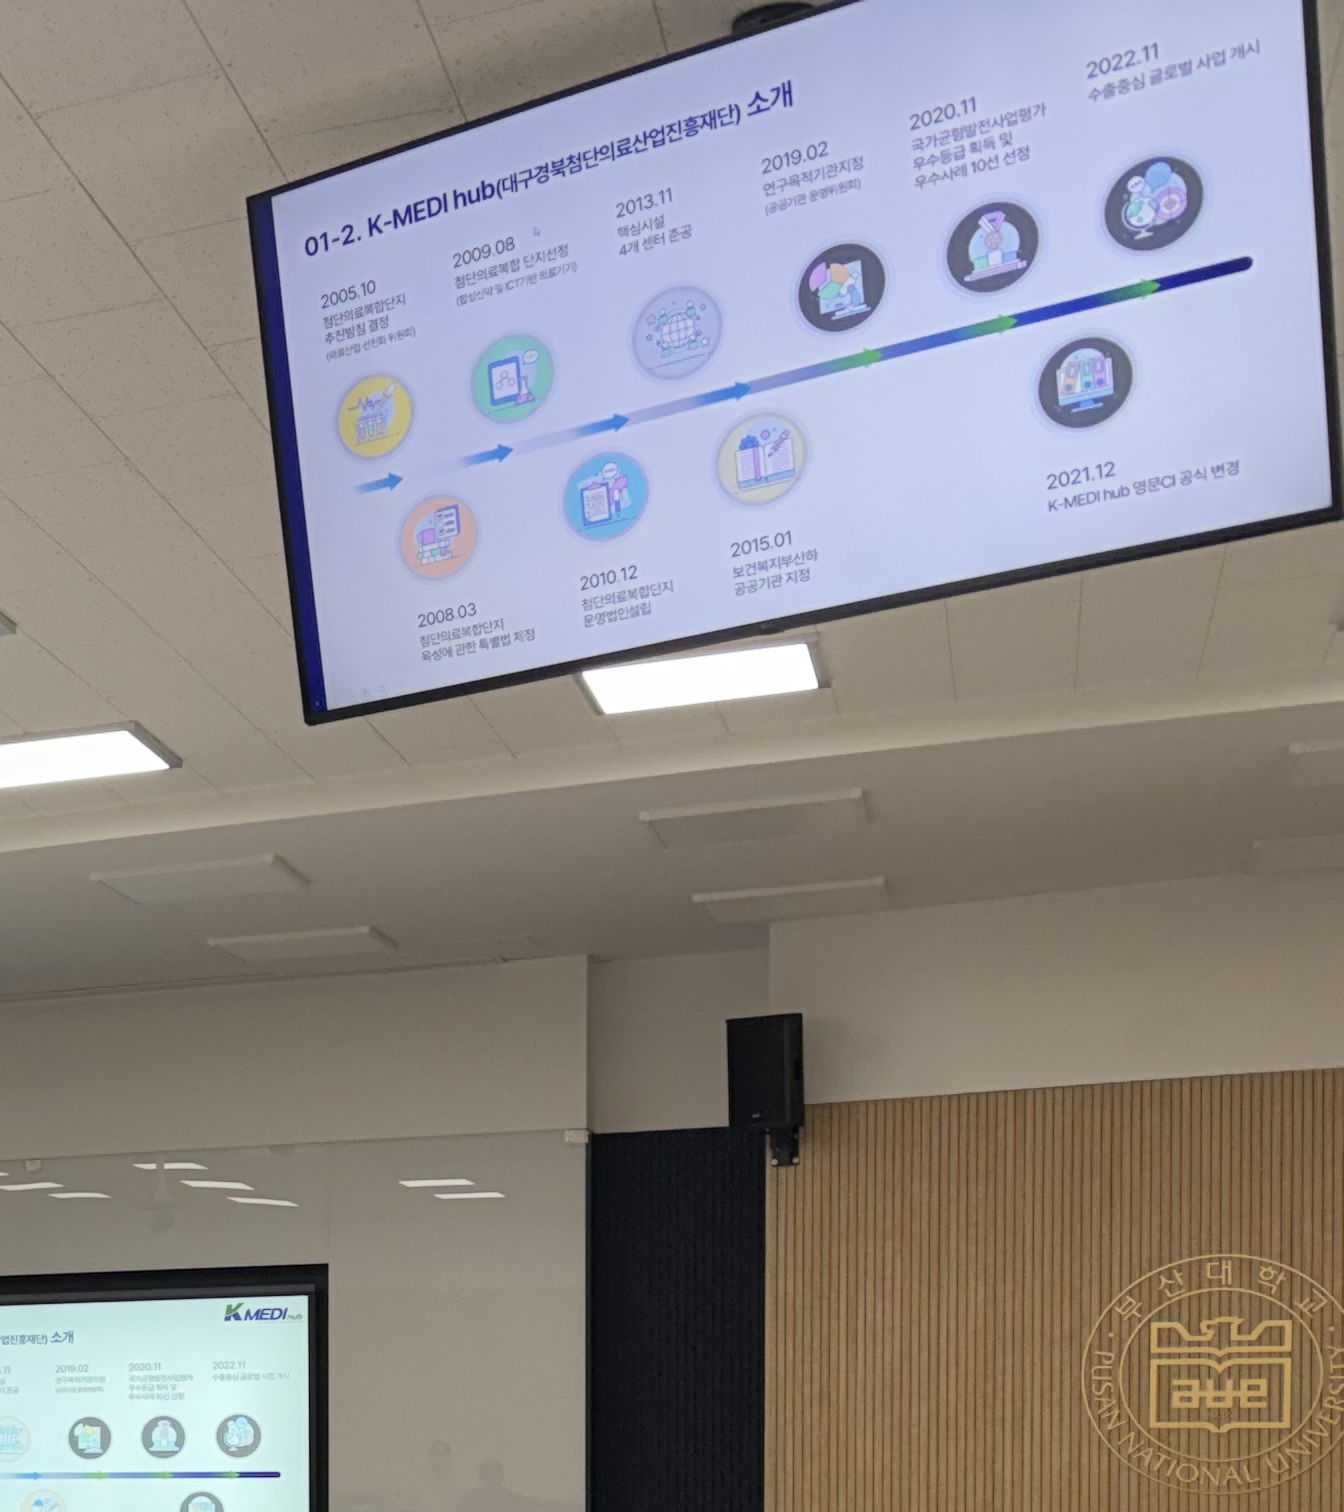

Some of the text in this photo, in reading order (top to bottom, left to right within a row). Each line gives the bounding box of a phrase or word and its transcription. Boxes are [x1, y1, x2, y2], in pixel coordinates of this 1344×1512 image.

[1086, 42, 1160, 80] 2022.11
[1149, 59, 1194, 86] 글로벌
[1196, 49, 1227, 70] 사업
[1229, 38, 1261, 60] 개시
[909, 96, 977, 131] 2020.11
[304, 223, 363, 257] 01-2.
[367, 193, 449, 238] K-MEDI
[747, 80, 794, 118] 소개
[761, 140, 829, 175] 2019.02
[970, 153, 1000, 174] 10선
[1003, 145, 1031, 166] 선정
[615, 187, 673, 219] 2013.11
[452, 236, 516, 269] 2009.08
[618, 223, 694, 256] 4개 센터 준공
[320, 279, 376, 310] 2005.10
[1045, 461, 1116, 491] 2021.12
[1047, 489, 1101, 513] K-MEDI
[1102, 485, 1131, 502] hub
[1179, 465, 1208, 487] 공식
[1211, 459, 1241, 480] 변경
[730, 530, 793, 558] 2015.01
[579, 565, 639, 591] 2010.12
[734, 567, 812, 597] 공공기관 지정
[417, 602, 477, 628] 2008.03
[1114, 1259, 1329, 1321] 부산대학교
[50, 1330, 75, 1344] 소개
[128, 1362, 162, 1372] 2020.11
[1091, 1350, 1127, 1431] PUSAN
[1118, 1431, 1260, 1487] NATIONAL
